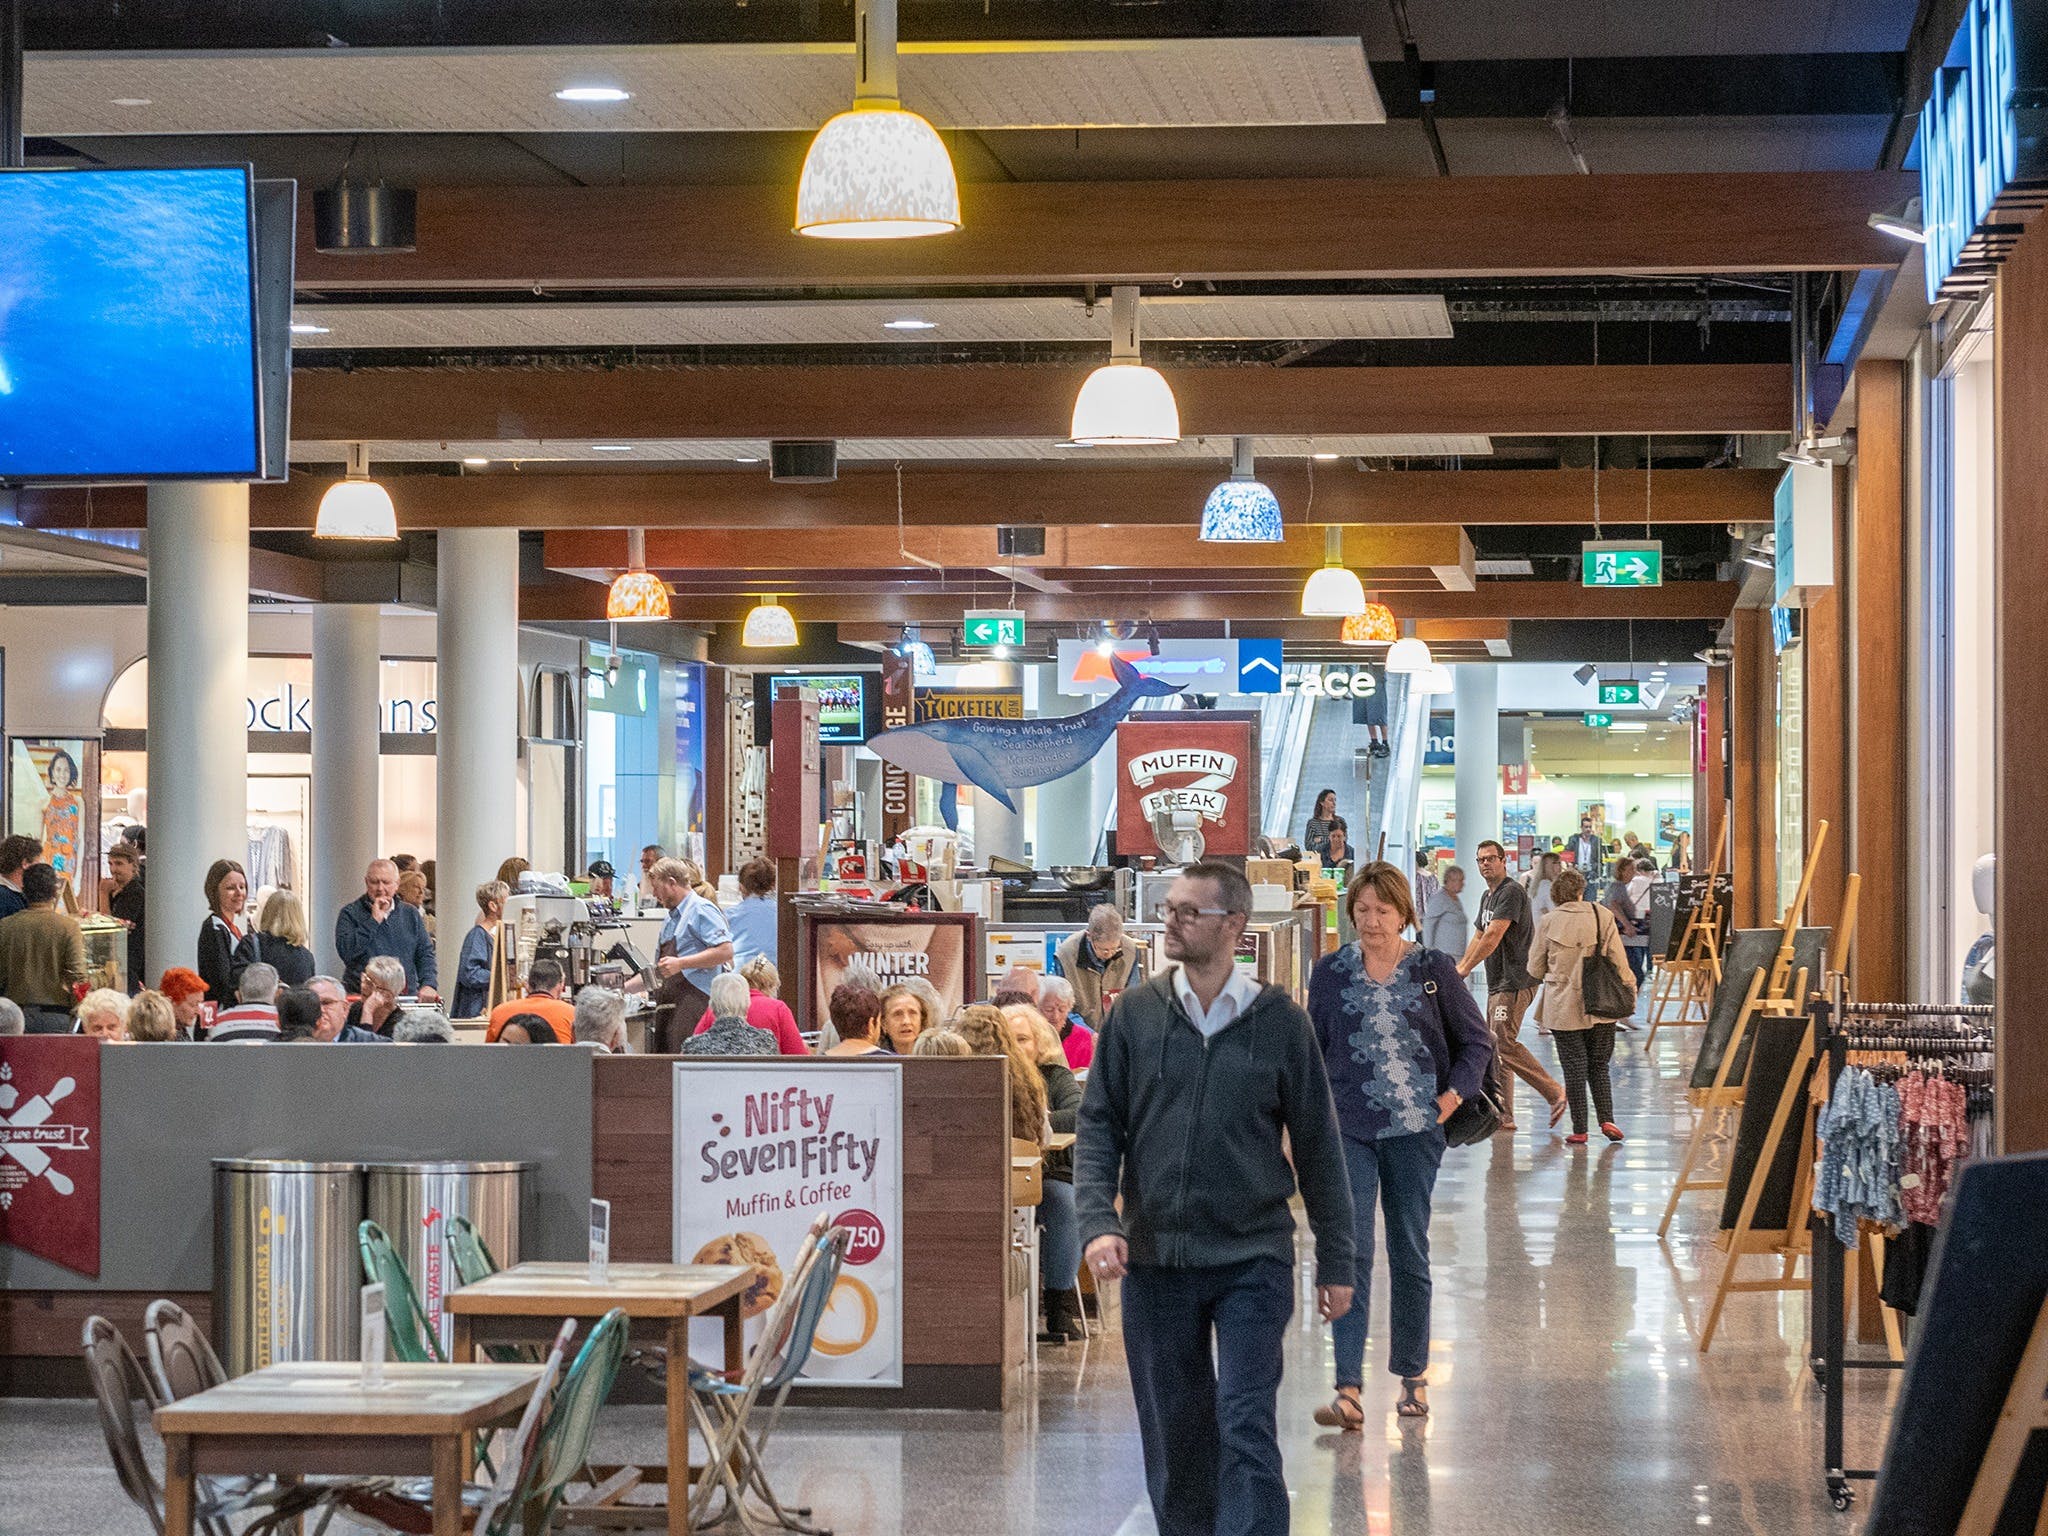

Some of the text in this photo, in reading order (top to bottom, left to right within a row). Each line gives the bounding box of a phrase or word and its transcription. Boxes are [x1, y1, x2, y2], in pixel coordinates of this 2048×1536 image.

[1280, 671, 1376, 698] race
[247, 683, 437, 733] ckns
[925, 700, 1004, 718] TICKETEK
[972, 717, 1088, 737] Gowings Whale Trust
[1001, 736, 1073, 751] Sea Shepherd
[885, 705, 907, 815] CONCGE
[1007, 751, 1072, 765] Merchandise
[1012, 765, 1061, 777] Sold here
[1141, 754, 1224, 773] MUFFIN
[848, 951, 929, 975] WINTER
[744, 1086, 835, 1138] Nifty
[33, 1127, 65, 1140] trust
[700, 1130, 880, 1184] Seven Fifty
[726, 1180, 852, 1219] Muffin & Coffee
[257, 1257, 270, 1303] CANS
[427, 1244, 441, 1300] WASTE
[257, 1307, 270, 1368] OTTLES
